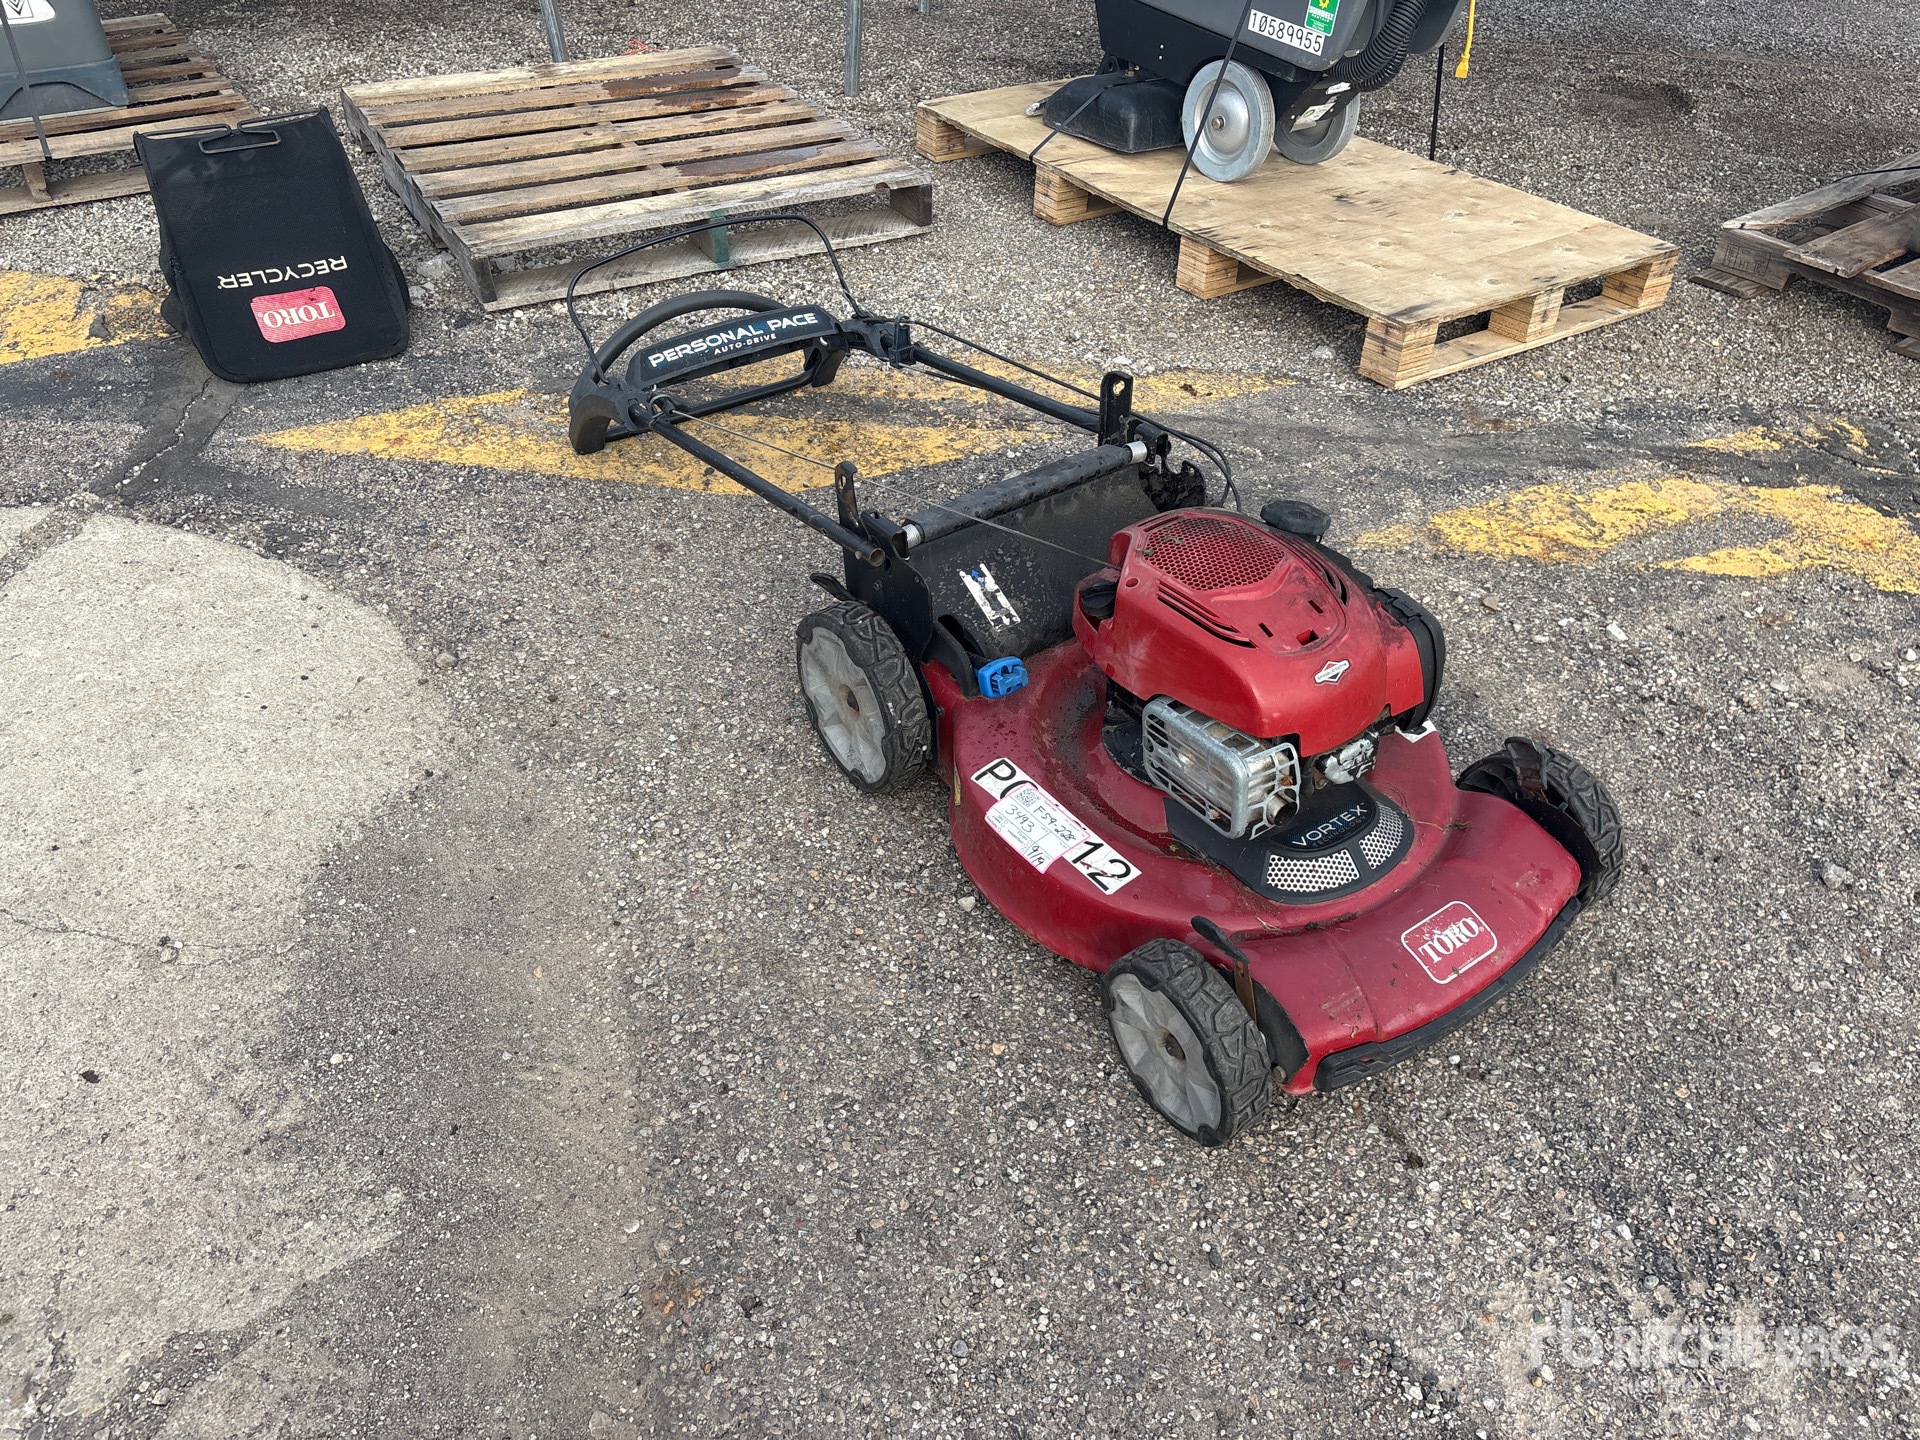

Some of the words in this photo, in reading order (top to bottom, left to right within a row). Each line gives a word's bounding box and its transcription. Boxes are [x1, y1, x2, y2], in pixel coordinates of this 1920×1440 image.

[1251, 12, 1323, 53] 10589955
[217, 255, 348, 289] RECYCLER
[262, 302, 336, 329] TORO
[647, 324, 763, 368] PERSONAL
[767, 312, 818, 332] PACE
[713, 333, 777, 355] AUTO-DRIVE
[1005, 804, 1035, 833] 3493
[1033, 805, 1076, 841] F59-228
[1291, 804, 1368, 846] VORTEX
[1312, 815, 1367, 848] TECHNOLOGY
[1417, 917, 1479, 965] TORO
